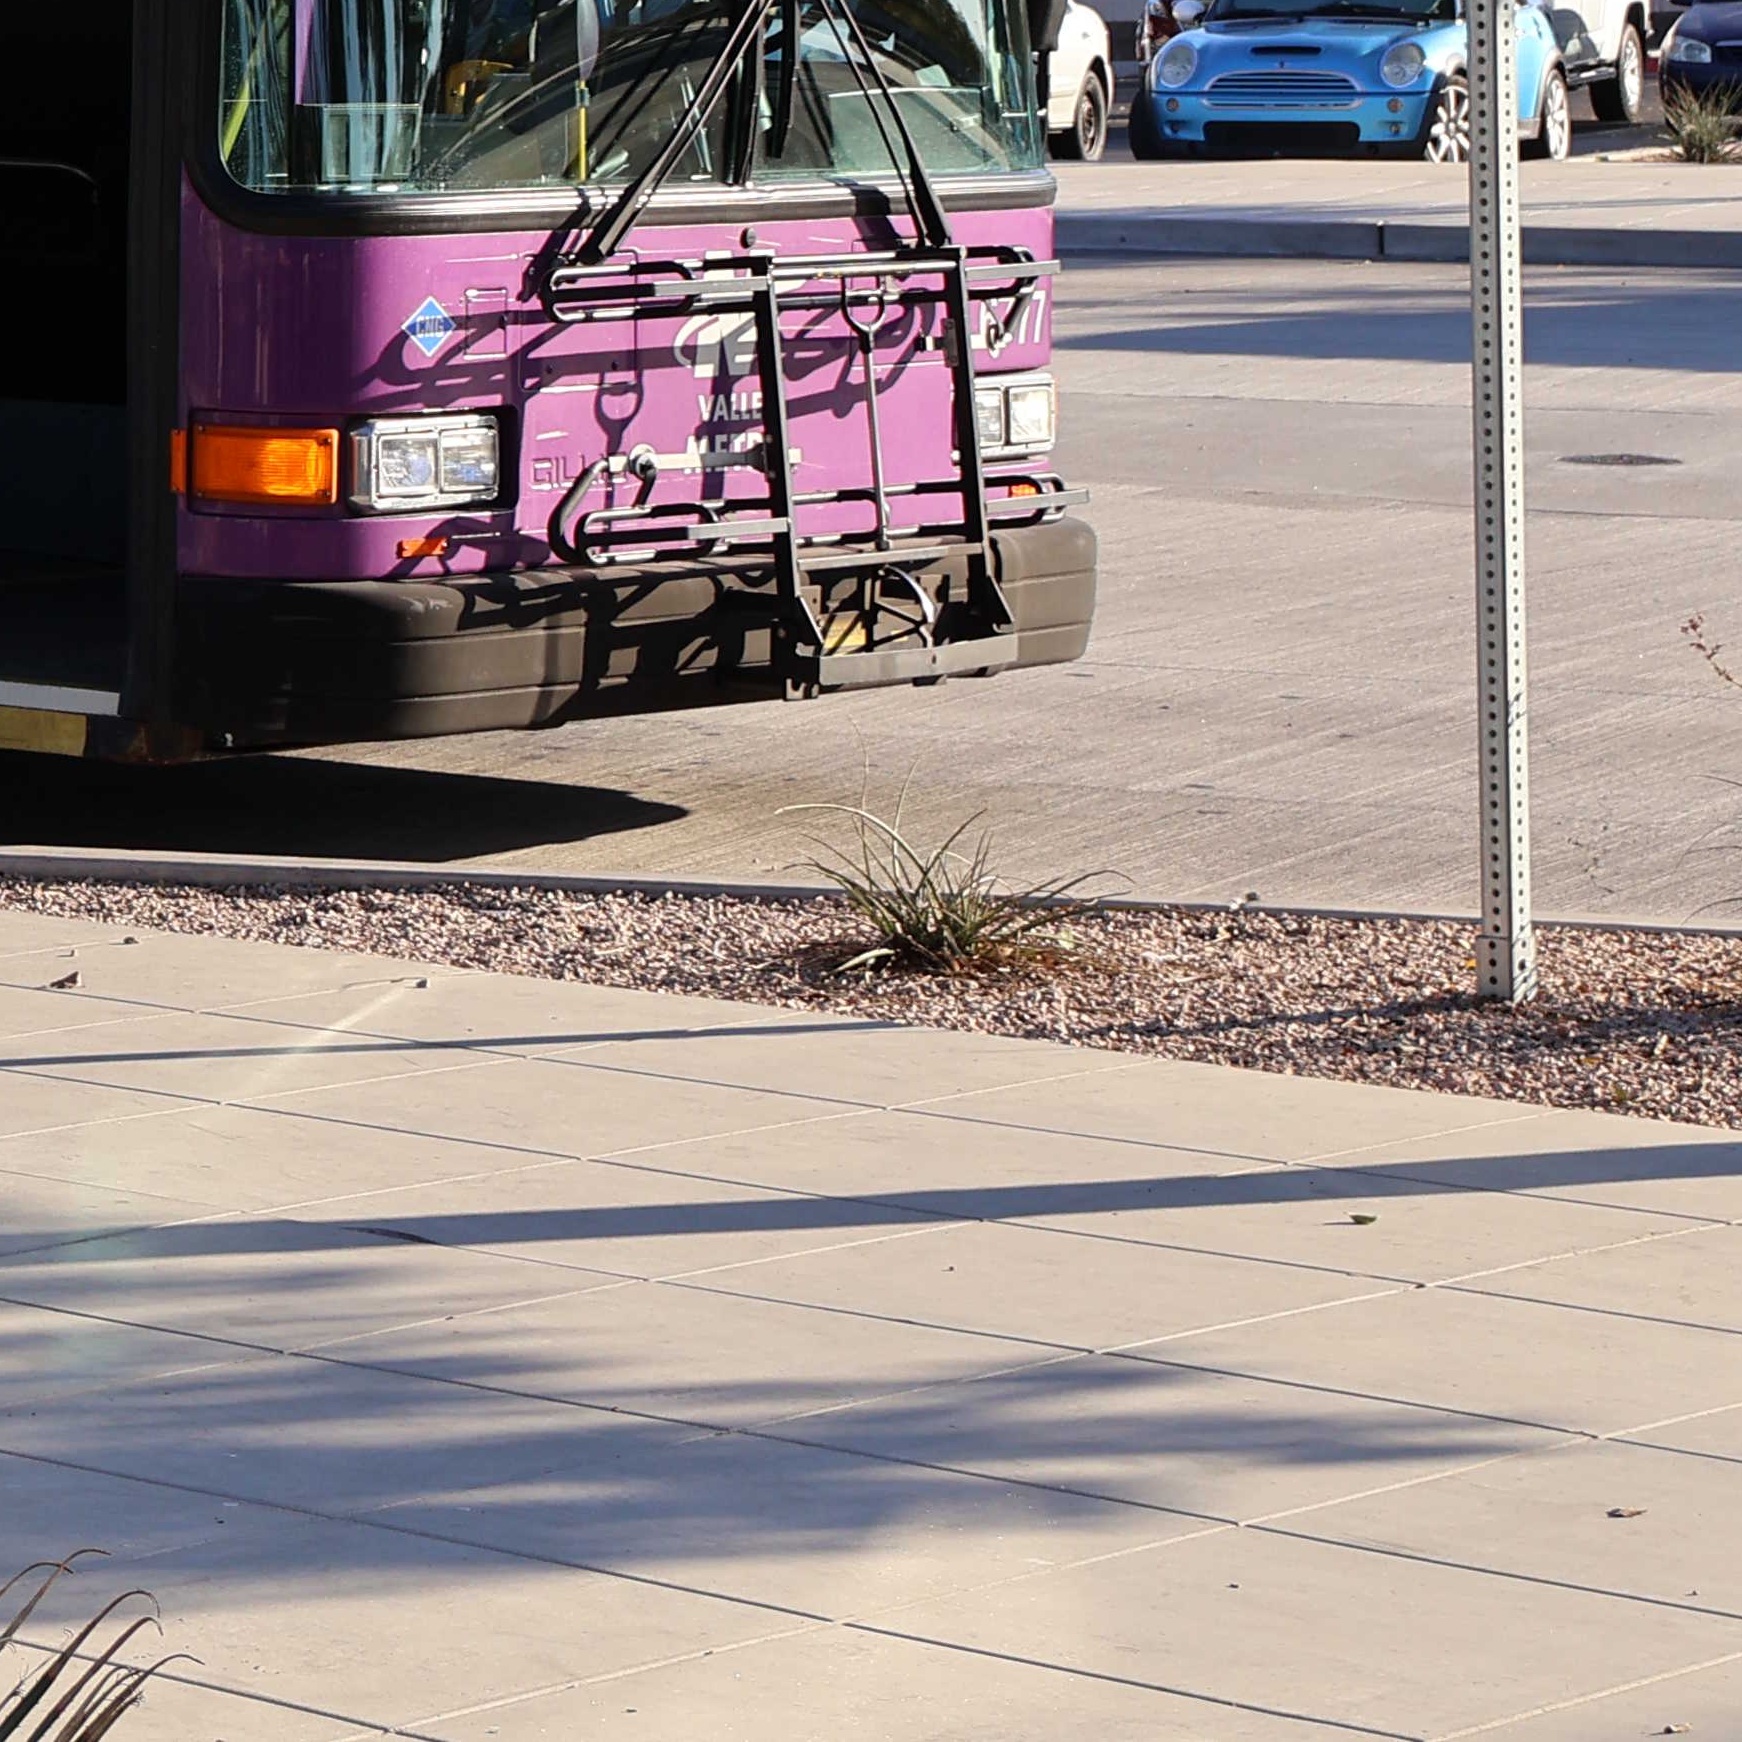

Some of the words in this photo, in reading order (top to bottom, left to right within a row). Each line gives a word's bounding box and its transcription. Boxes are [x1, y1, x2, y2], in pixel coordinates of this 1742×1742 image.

[416, 315, 445, 338] CNG
[698, 391, 764, 422] VALLE
[683, 432, 765, 475] METR
